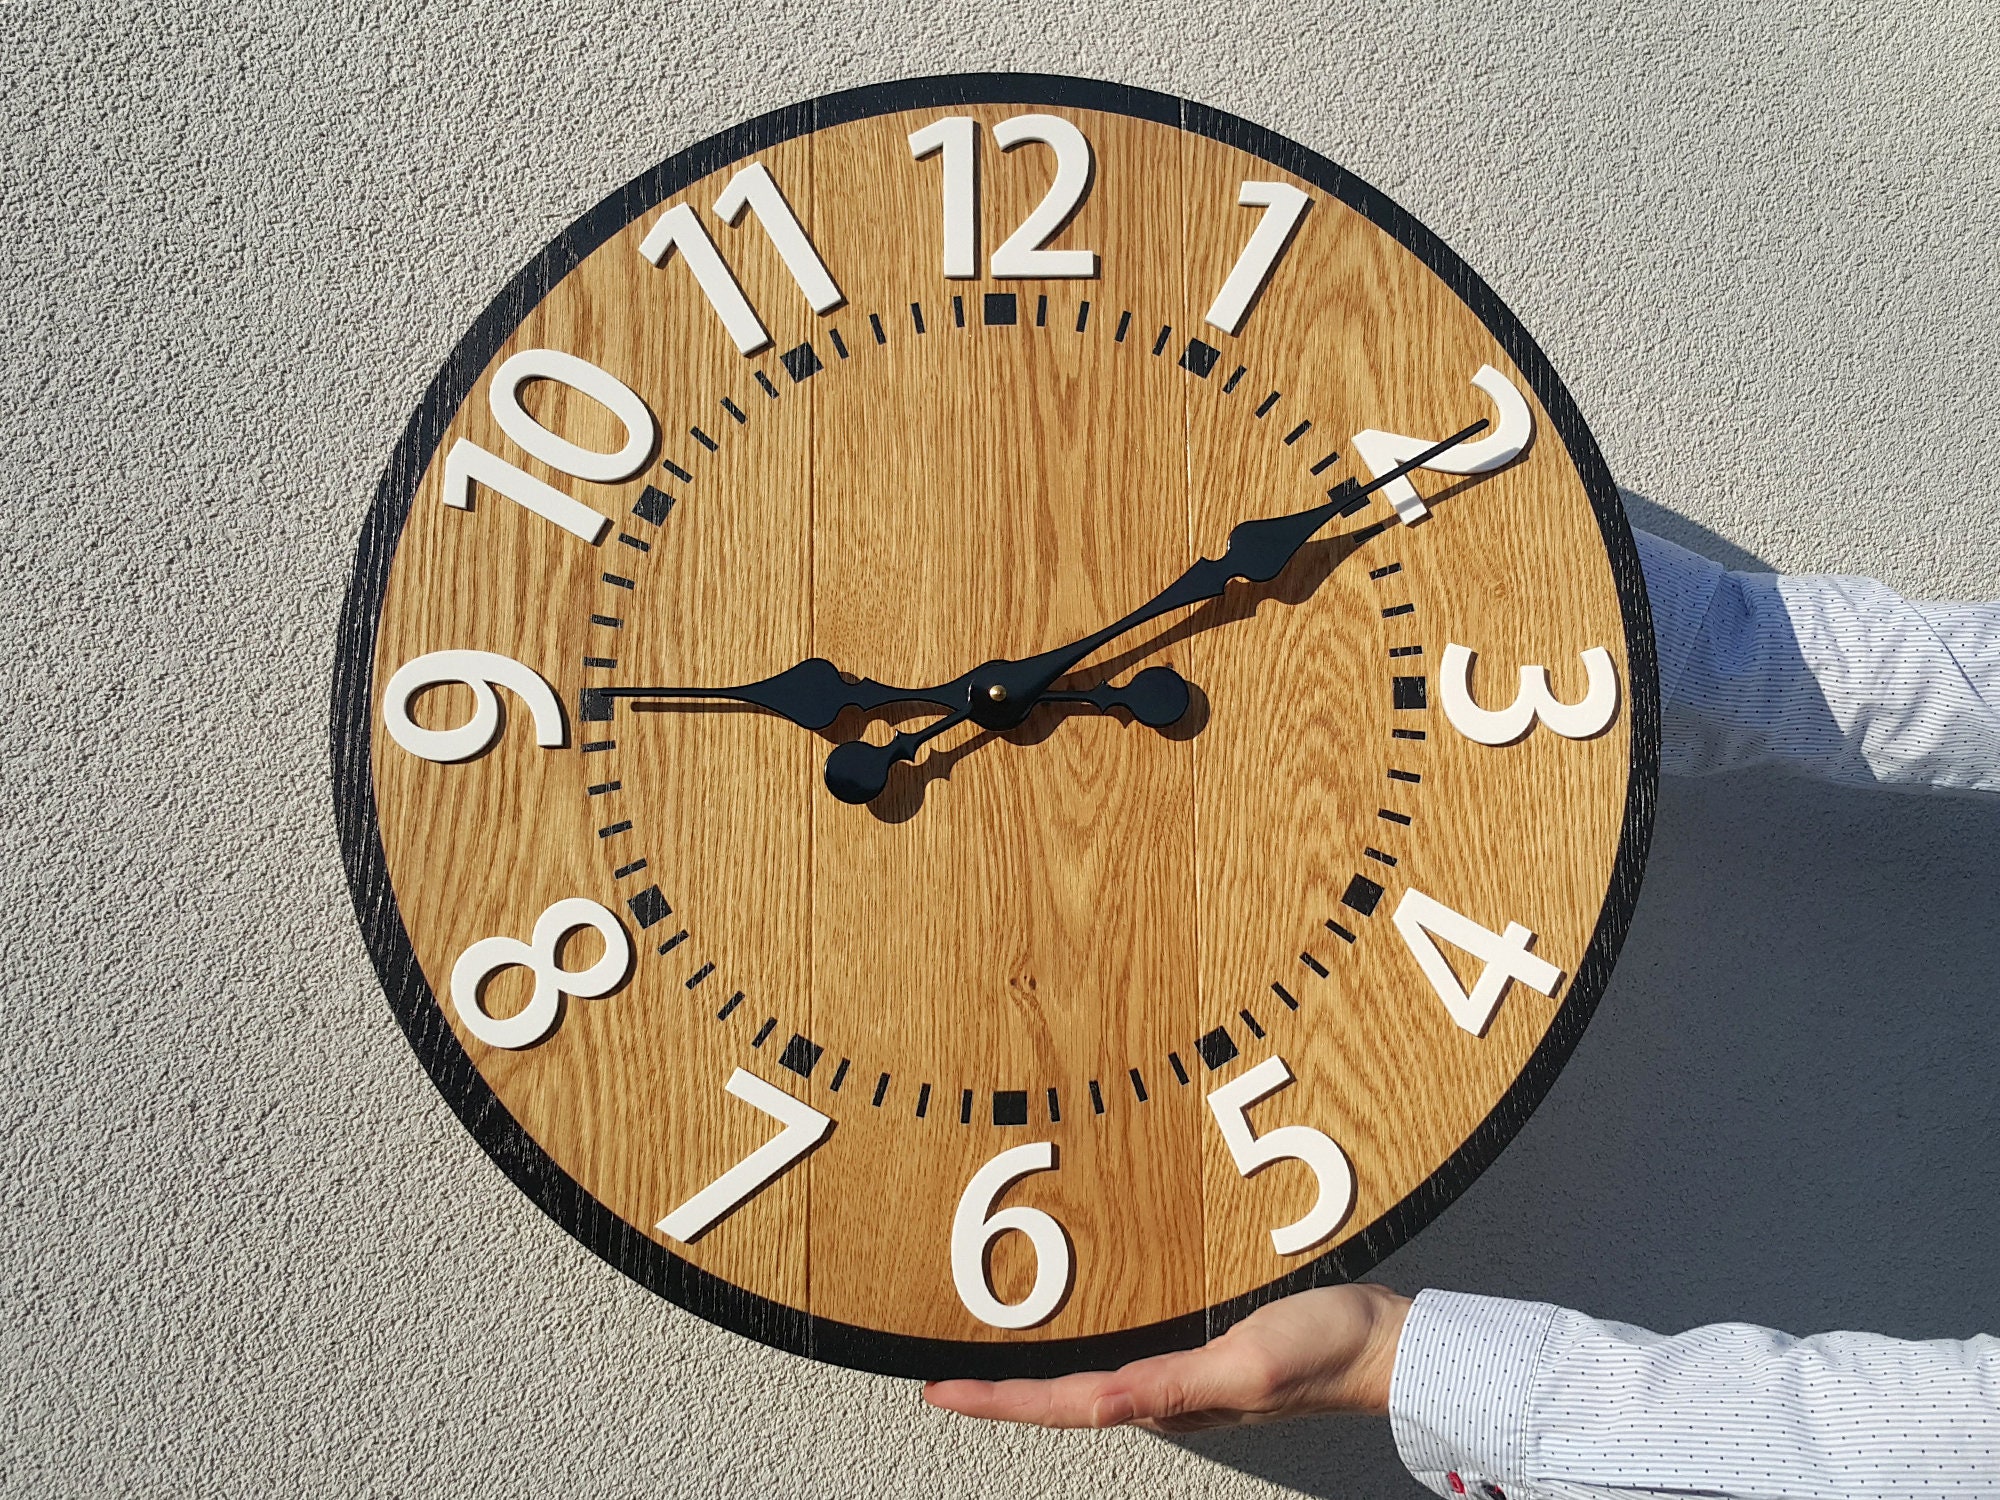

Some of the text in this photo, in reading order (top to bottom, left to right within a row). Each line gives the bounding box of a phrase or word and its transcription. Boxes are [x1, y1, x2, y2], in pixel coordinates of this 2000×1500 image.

[640, 162, 843, 354] 11
[909, 115, 1096, 279] 12
[1205, 180, 1309, 334] 1
[442, 349, 655, 543] 10
[1351, 364, 1533, 526] 2
[383, 649, 564, 763] 9
[1440, 642, 1617, 745] 3
[450, 897, 632, 1049] 8
[1392, 887, 1562, 1036] 4
[655, 1067, 832, 1242] 7
[951, 1142, 1070, 1329] 6
[1207, 1055, 1354, 1256] 5
